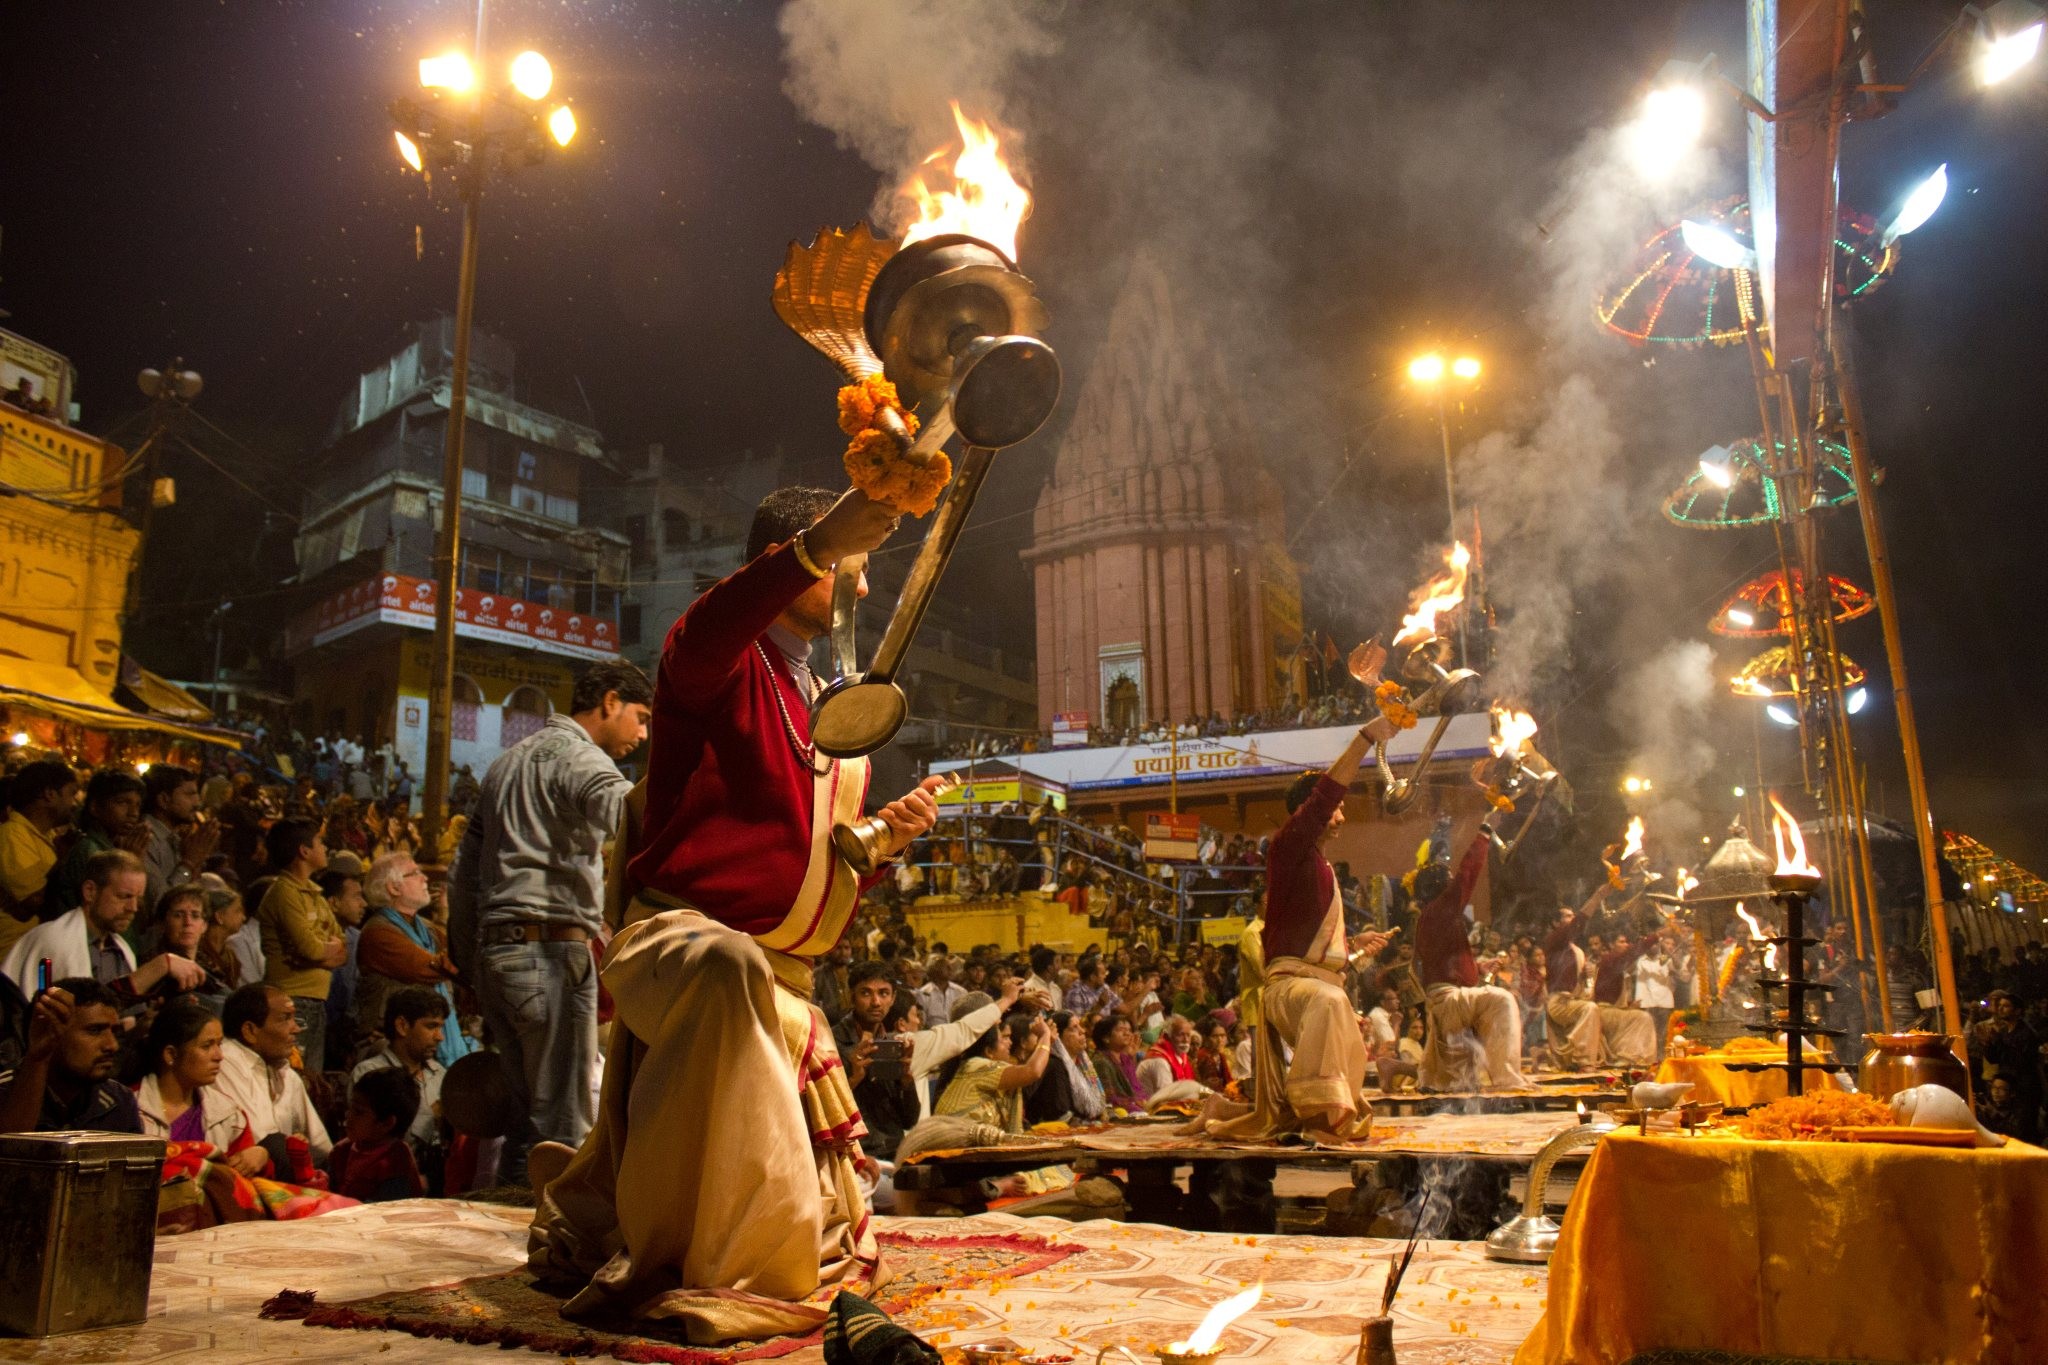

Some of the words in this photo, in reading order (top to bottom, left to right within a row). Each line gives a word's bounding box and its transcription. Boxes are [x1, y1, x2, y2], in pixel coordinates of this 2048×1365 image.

[381, 595, 402, 608] rtel
[409, 601, 435, 614] airtel
[474, 612, 498, 626] airtel
[505, 619, 529, 633] airtel
[535, 625, 558, 639] airtel
[564, 631, 585, 645] airtel
[592, 638, 613, 649] airtel
[1133, 755, 1191, 775] प्रयाग
[1198, 751, 1239, 769] घाट
